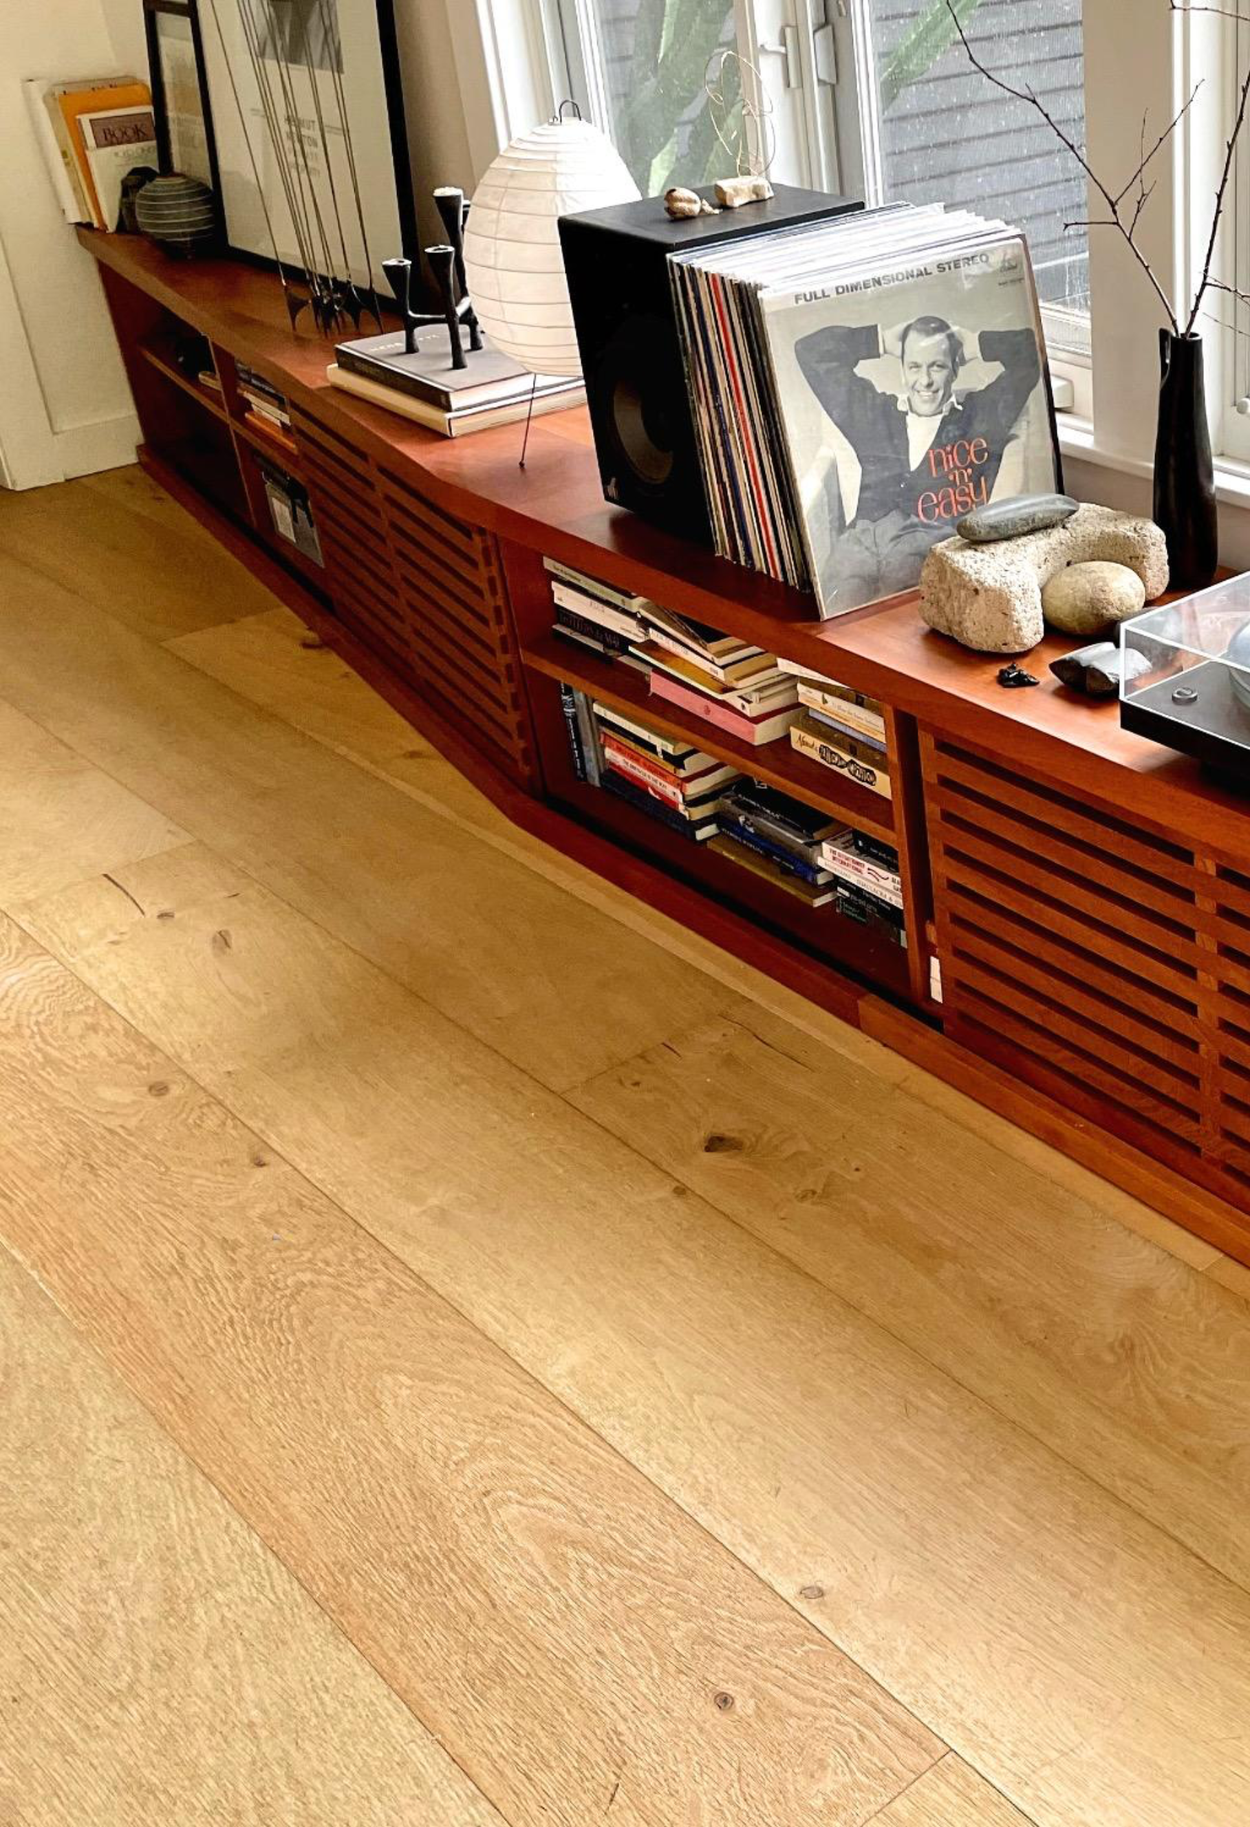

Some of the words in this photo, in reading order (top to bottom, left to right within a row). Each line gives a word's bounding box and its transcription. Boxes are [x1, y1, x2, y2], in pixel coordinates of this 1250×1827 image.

[794, 287, 831, 304] FULL
[835, 266, 933, 296] DIMENSIONAL
[936, 253, 990, 273] STEREO
[928, 438, 988, 477] nice
[918, 476, 987, 523] easy
